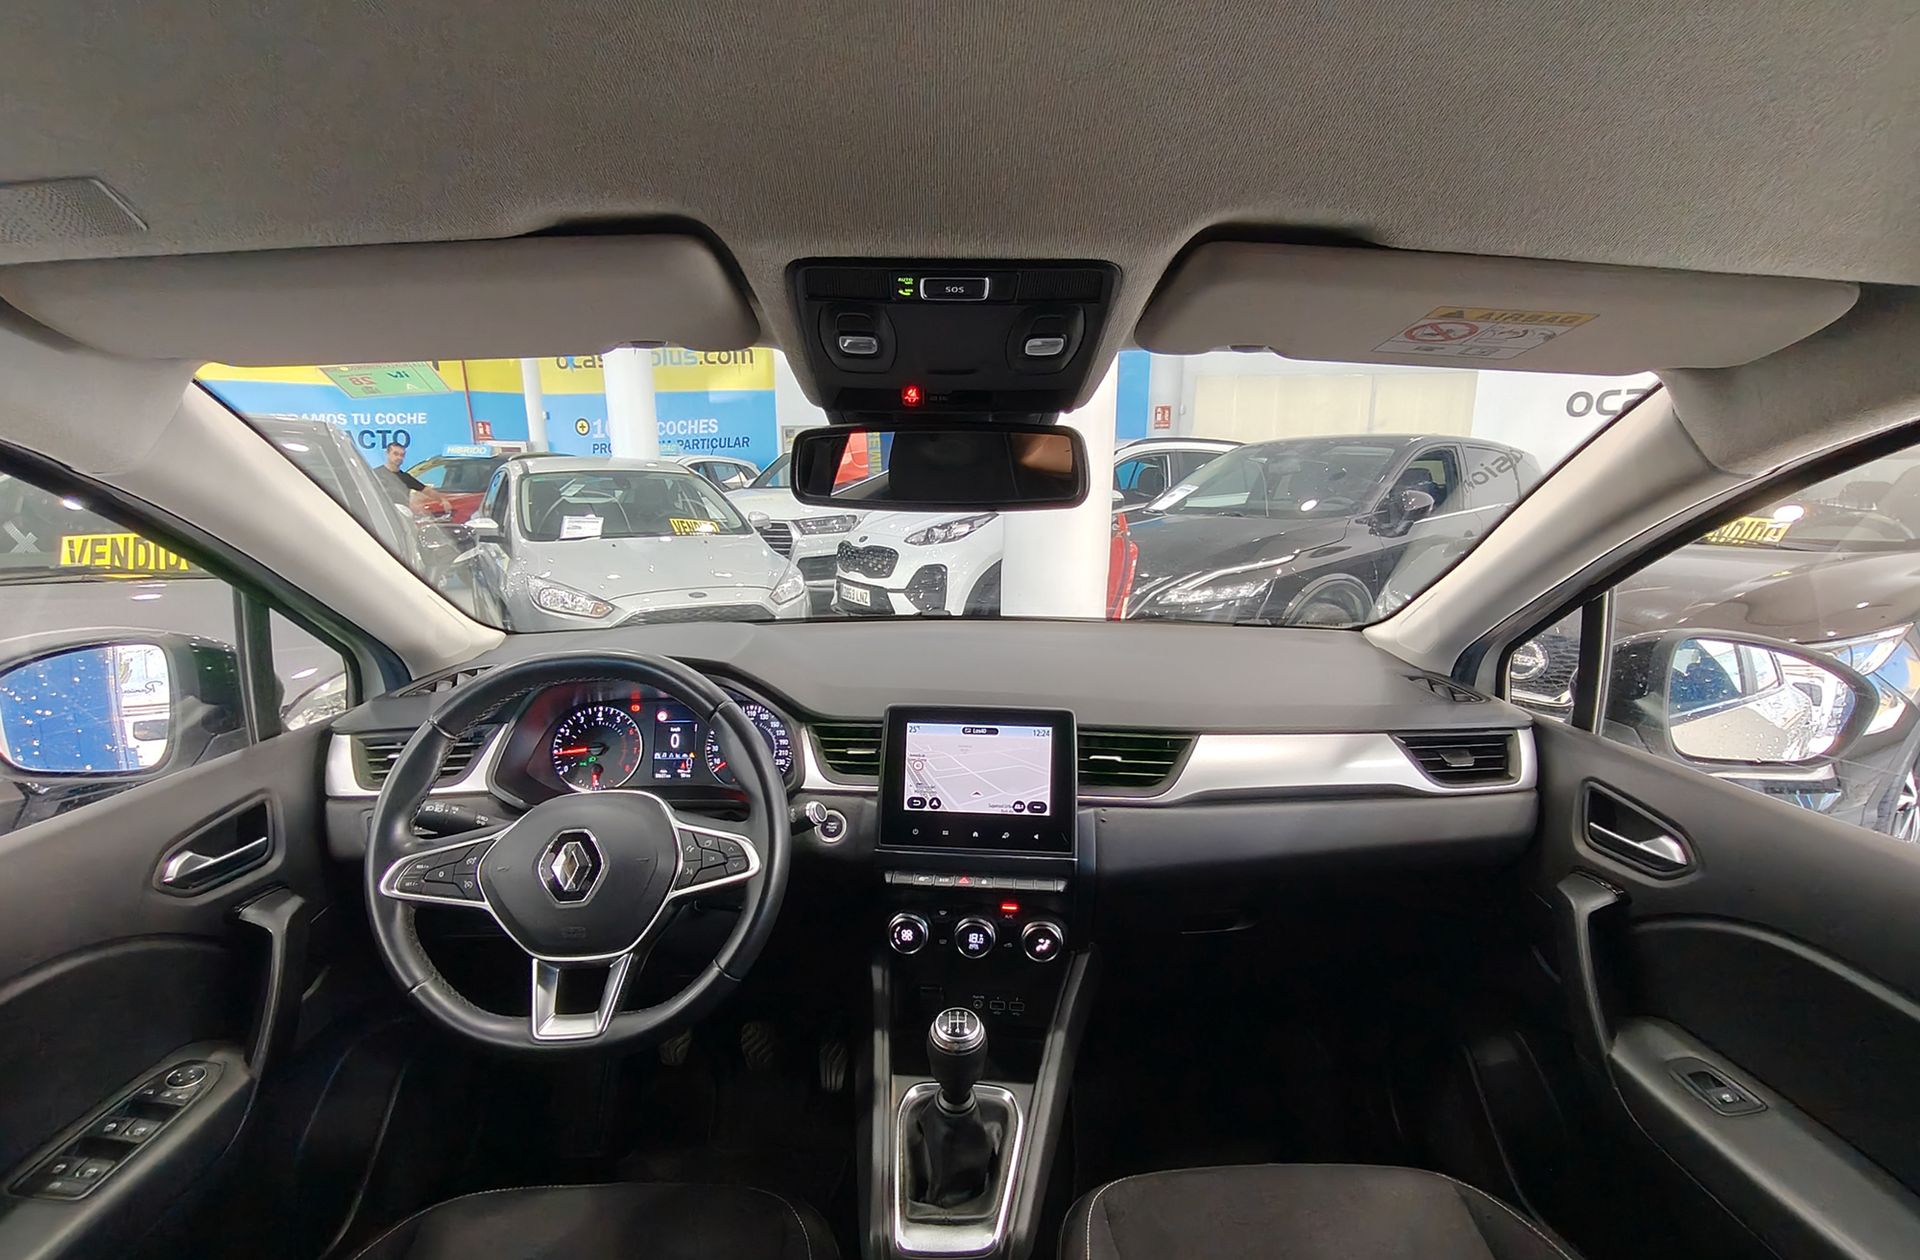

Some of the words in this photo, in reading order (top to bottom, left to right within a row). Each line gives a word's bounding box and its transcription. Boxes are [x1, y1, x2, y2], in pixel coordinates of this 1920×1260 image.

[351, 413, 371, 425] TU
[375, 412, 428, 425] COCHE
[657, 418, 719, 435] COCHES
[677, 436, 751, 451] PARTICULAR
[1033, 729, 1050, 737] 12:24
[671, 733, 680, 749] 0
